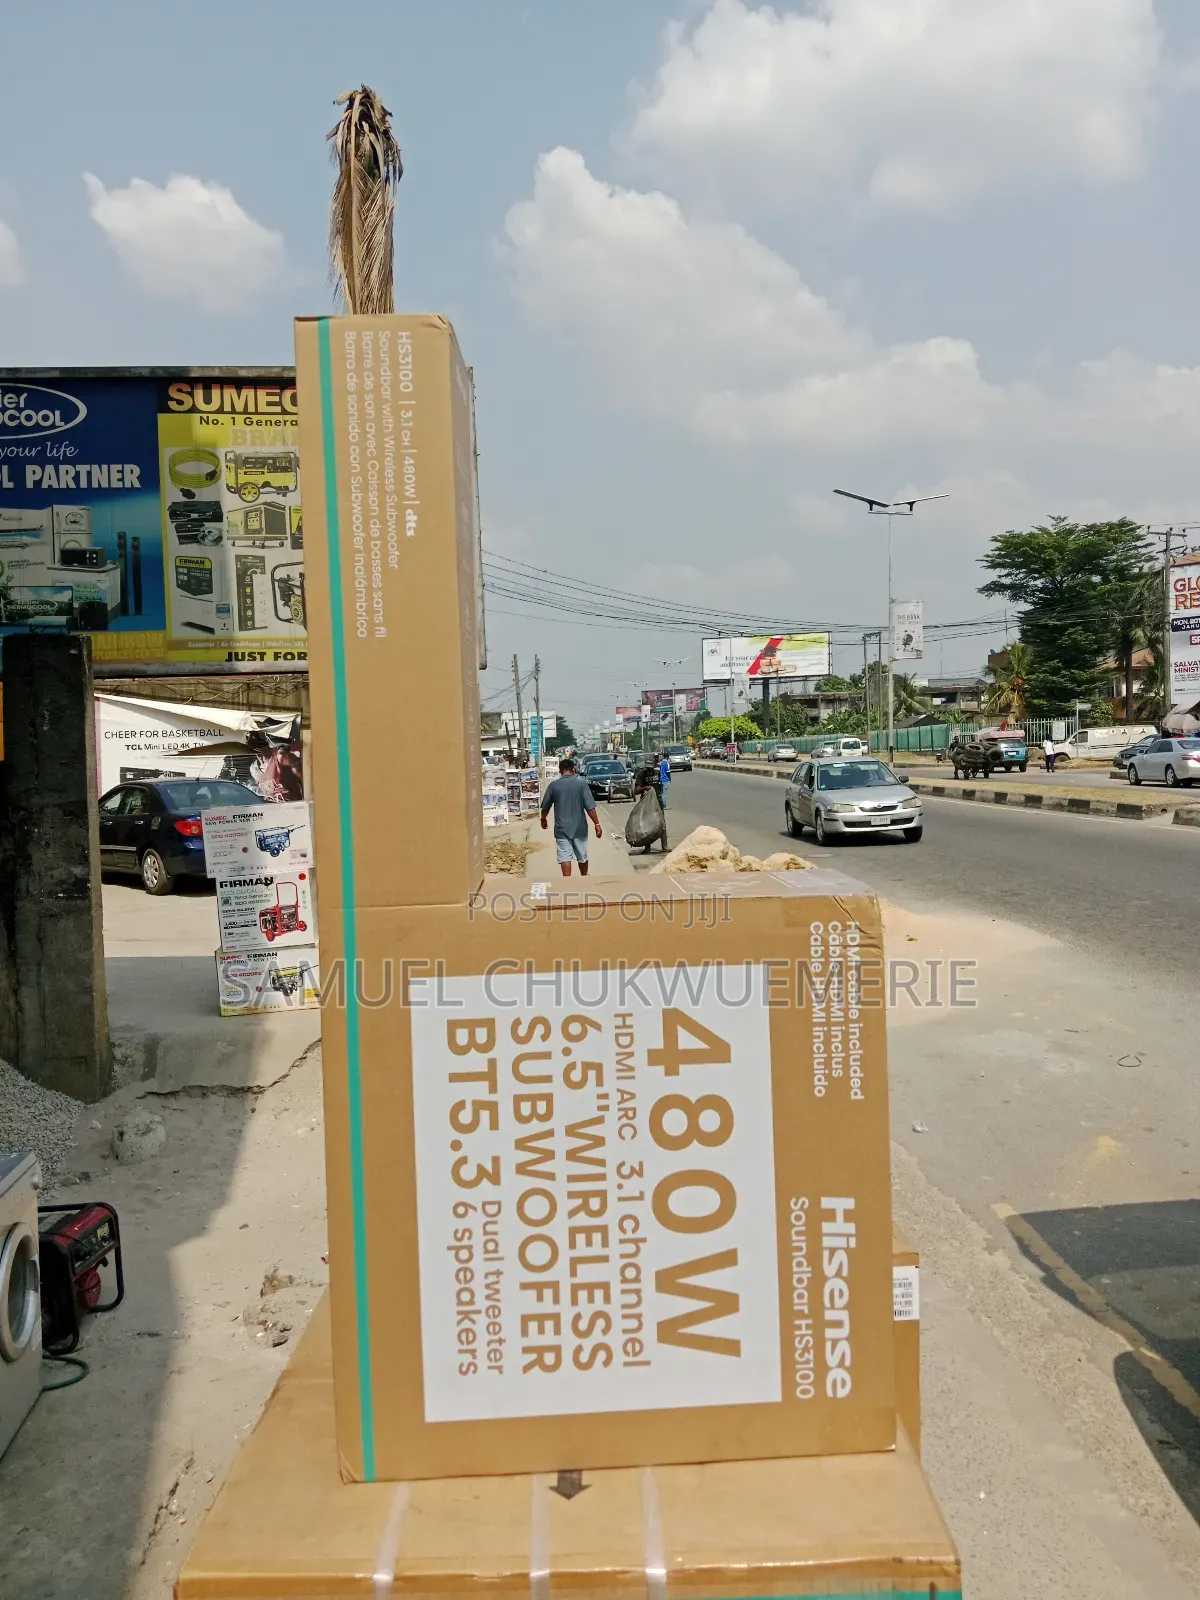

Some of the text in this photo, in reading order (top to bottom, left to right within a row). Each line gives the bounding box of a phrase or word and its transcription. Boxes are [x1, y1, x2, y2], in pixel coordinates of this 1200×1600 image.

[345, 331, 357, 369] Barra
[398, 331, 413, 392] HS3100
[347, 372, 359, 391] de
[0, 410, 65, 427] COOL
[200, 416, 225, 426] No.
[230, 416, 237, 426] 1
[348, 394, 361, 442] sonido
[401, 410, 413, 426] 3.1
[45, 441, 79, 460] life
[350, 446, 361, 473] con
[379, 330, 400, 569] Soundbar with Wireless Subwoofer
[26, 463, 141, 489] PARTNER
[362, 331, 387, 638] Barre de son avec Caisson de basses sans fil
[404, 456, 417, 498] 480W
[351, 476, 366, 551] Subwoofer
[406, 508, 418, 537] dts
[225, 651, 308, 663] JUST FOR
[104, 728, 224, 739] CHEER FOR BASKETBALL
[144, 743, 160, 751] Mini
[162, 742, 179, 750] LED
[180, 742, 191, 750] 4K
[232, 812, 264, 820] FIRMAN
[219, 876, 274, 889] FIRMAN
[809, 921, 828, 1098] Cable HDMI incluido
[827, 920, 846, 1078] Câble HDMI inclus
[846, 921, 865, 1100] HDMI cable included
[446, 1017, 501, 1189] BT5.3
[510, 1015, 563, 1375] SUBWOOFER
[613, 1012, 652, 1368] HDMI ARC 3.1 channel
[647, 1007, 741, 1358] 480W
[446, 1200, 482, 1377] 6 speakers
[481, 1200, 507, 1375] Dual tweeter
[790, 1197, 815, 1400] Soundbar HS3100
[820, 1196, 857, 1399] Hisense
